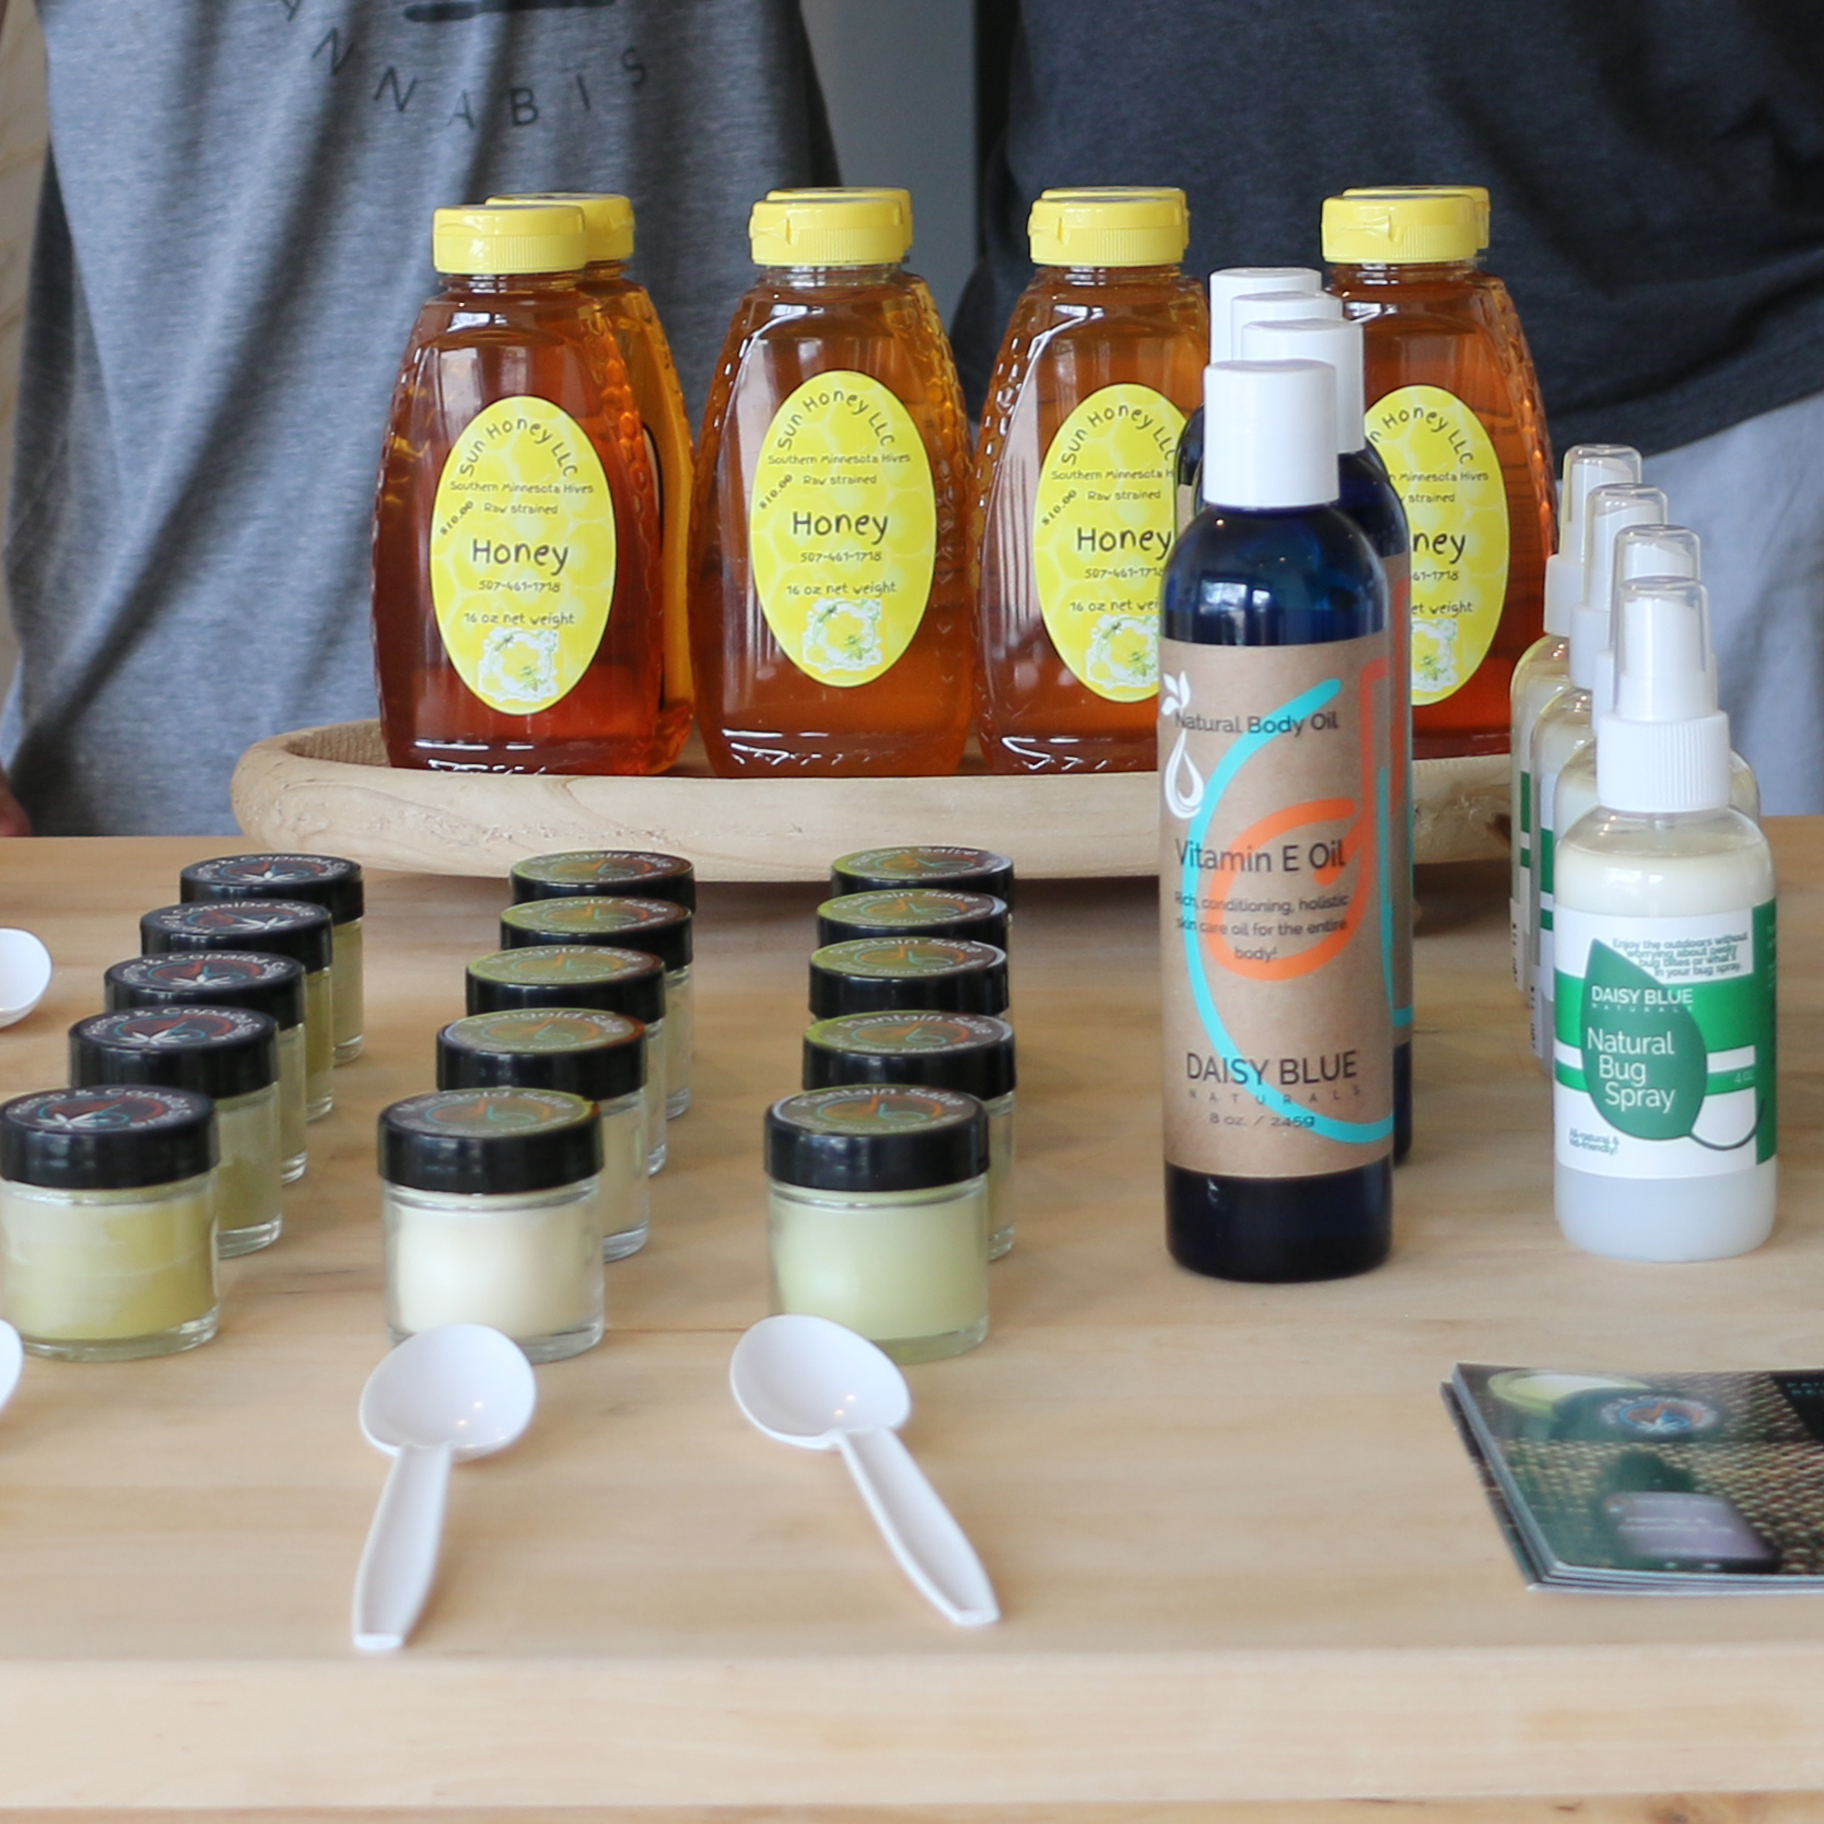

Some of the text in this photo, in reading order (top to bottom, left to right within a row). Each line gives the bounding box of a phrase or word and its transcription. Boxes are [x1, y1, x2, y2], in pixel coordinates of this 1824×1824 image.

[777, 390, 896, 451] Sun Honey LLC
[1062, 404, 1176, 466] Sun Honey LLC
[1382, 406, 1475, 466] Honey LLC
[459, 417, 578, 477] Sun Honey LLC
[450, 480, 594, 494] Southern Minnesota Hives
[484, 503, 558, 514] Raw strained
[792, 511, 889, 545] Honey
[1077, 527, 1173, 560] Honey
[472, 538, 569, 576] Honey
[1413, 531, 1466, 565] ney
[464, 611, 575, 629] 16 oz net weight
[1176, 712, 1338, 737] Natural Body Oil
[1176, 838, 1345, 873] Vitamin E Oil
[1592, 986, 1694, 1004] DAISY BLUE
[1587, 1027, 1674, 1055] Natural
[1186, 1050, 1357, 1085] DAISY BLUE
[1599, 1055, 1646, 1086] Bug
[1189, 1087, 1360, 1105] NATURALS
[1605, 1081, 1675, 1113] Spray
